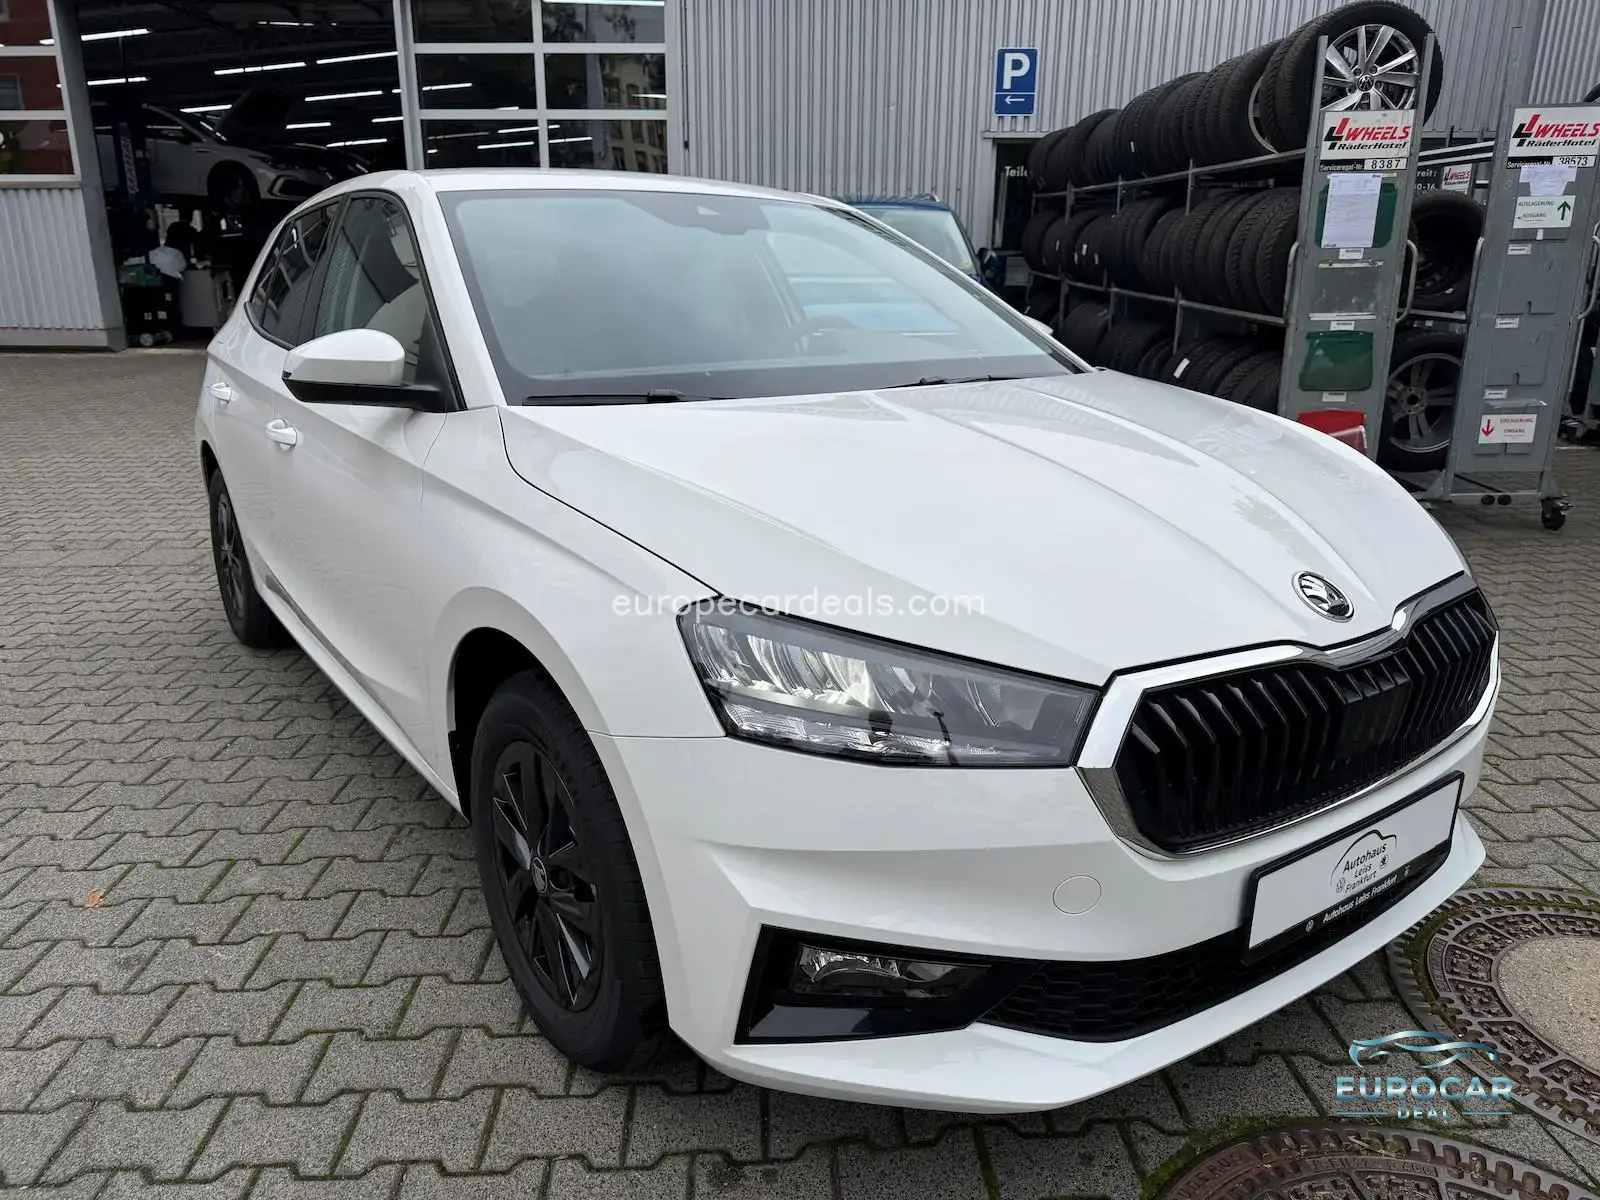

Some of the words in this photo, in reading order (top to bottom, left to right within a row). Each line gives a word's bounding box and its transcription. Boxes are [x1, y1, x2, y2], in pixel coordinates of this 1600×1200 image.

[1003, 52, 1031, 90] P
[1371, 159, 1401, 169] 8387
[1560, 156, 1588, 166] 38573
[1343, 843, 1387, 873] Autohaus
[1345, 870, 1376, 893] Frankfurt
[1355, 864, 1372, 878] Leiss
[1323, 901, 1353, 923] Autohaus
[1355, 892, 1370, 905] Leiss
[1371, 874, 1397, 896] Frankfurt
